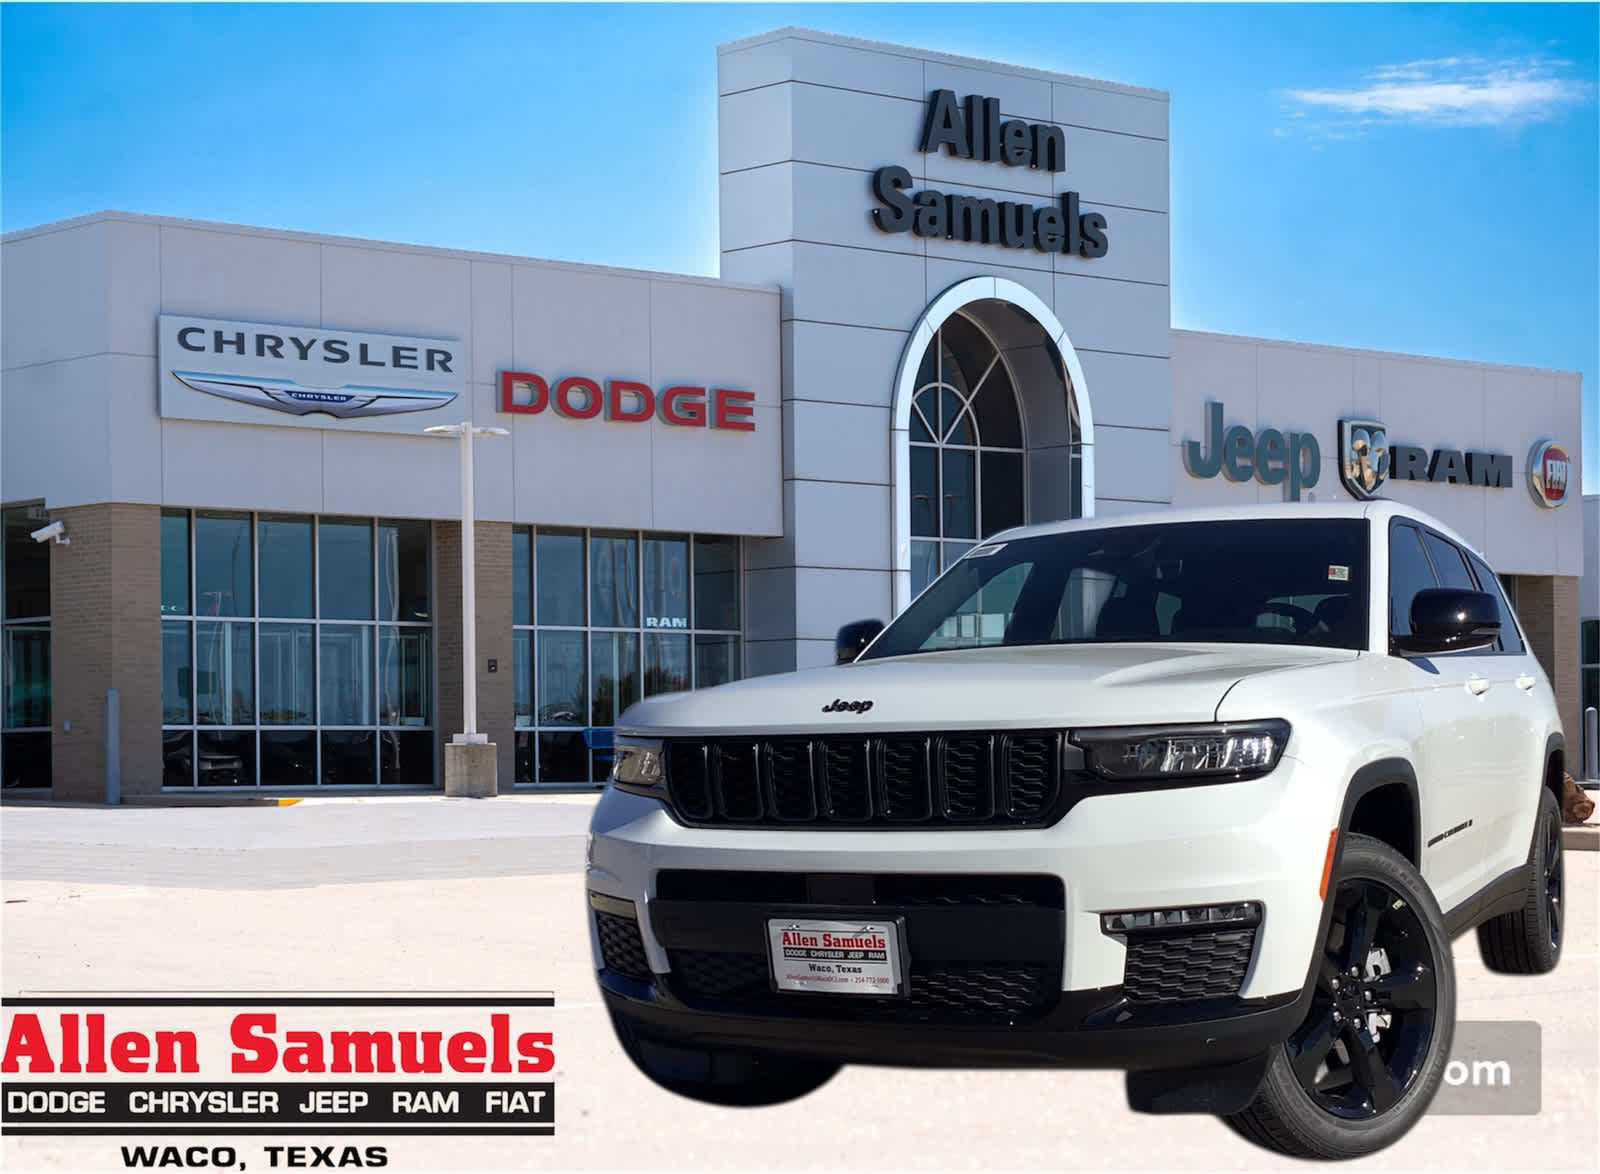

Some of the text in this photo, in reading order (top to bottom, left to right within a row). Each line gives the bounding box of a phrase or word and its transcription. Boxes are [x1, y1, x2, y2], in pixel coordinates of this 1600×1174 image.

[918, 89, 1066, 172] Allen
[872, 165, 1108, 258] Samuels
[177, 326, 454, 373] CHRYSLER
[291, 392, 347, 401] CHRYSLER
[496, 370, 756, 432] DODGE
[1182, 401, 1321, 502] Jeep
[1389, 445, 1513, 488] RAM
[1546, 459, 1567, 490] FIAT
[646, 616, 688, 628] RAM
[821, 698, 874, 714] Jeep
[782, 931, 886, 949] Allen Samuels
[810, 949, 845, 958] CHRYSLER
[847, 951, 865, 960] JEEP
[868, 951, 886, 960] RAM
[808, 962, 863, 974] Waco, Texas
